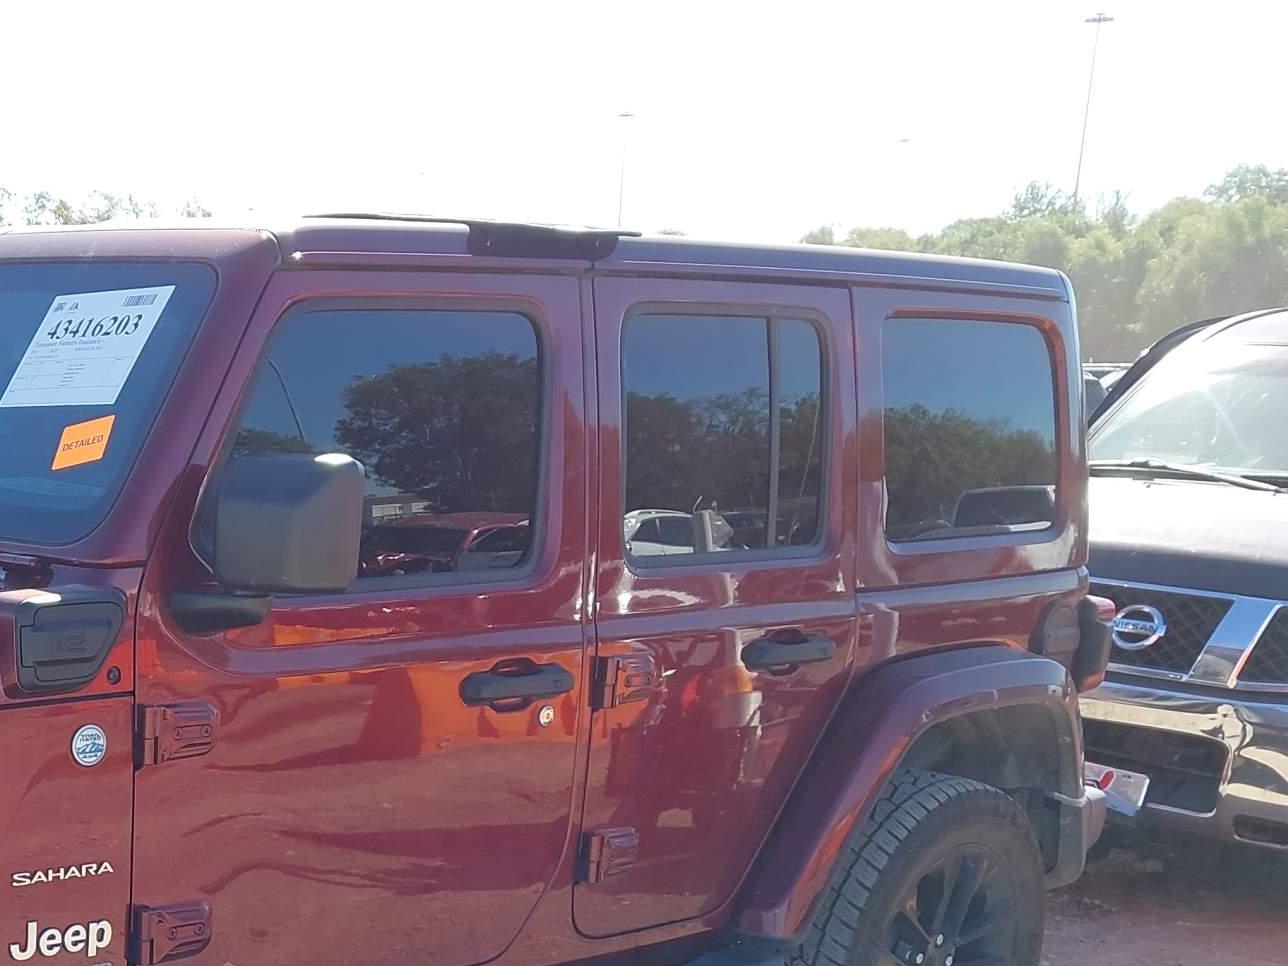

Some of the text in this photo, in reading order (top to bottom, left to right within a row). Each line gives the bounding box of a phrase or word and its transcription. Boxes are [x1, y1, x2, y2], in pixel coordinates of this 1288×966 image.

[47, 314, 143, 339] 43416203
[63, 434, 104, 451] DETAILED
[1113, 620, 1159, 633] NISSAN
[12, 861, 114, 887] SAHARA
[10, 920, 112, 960] Jeep
